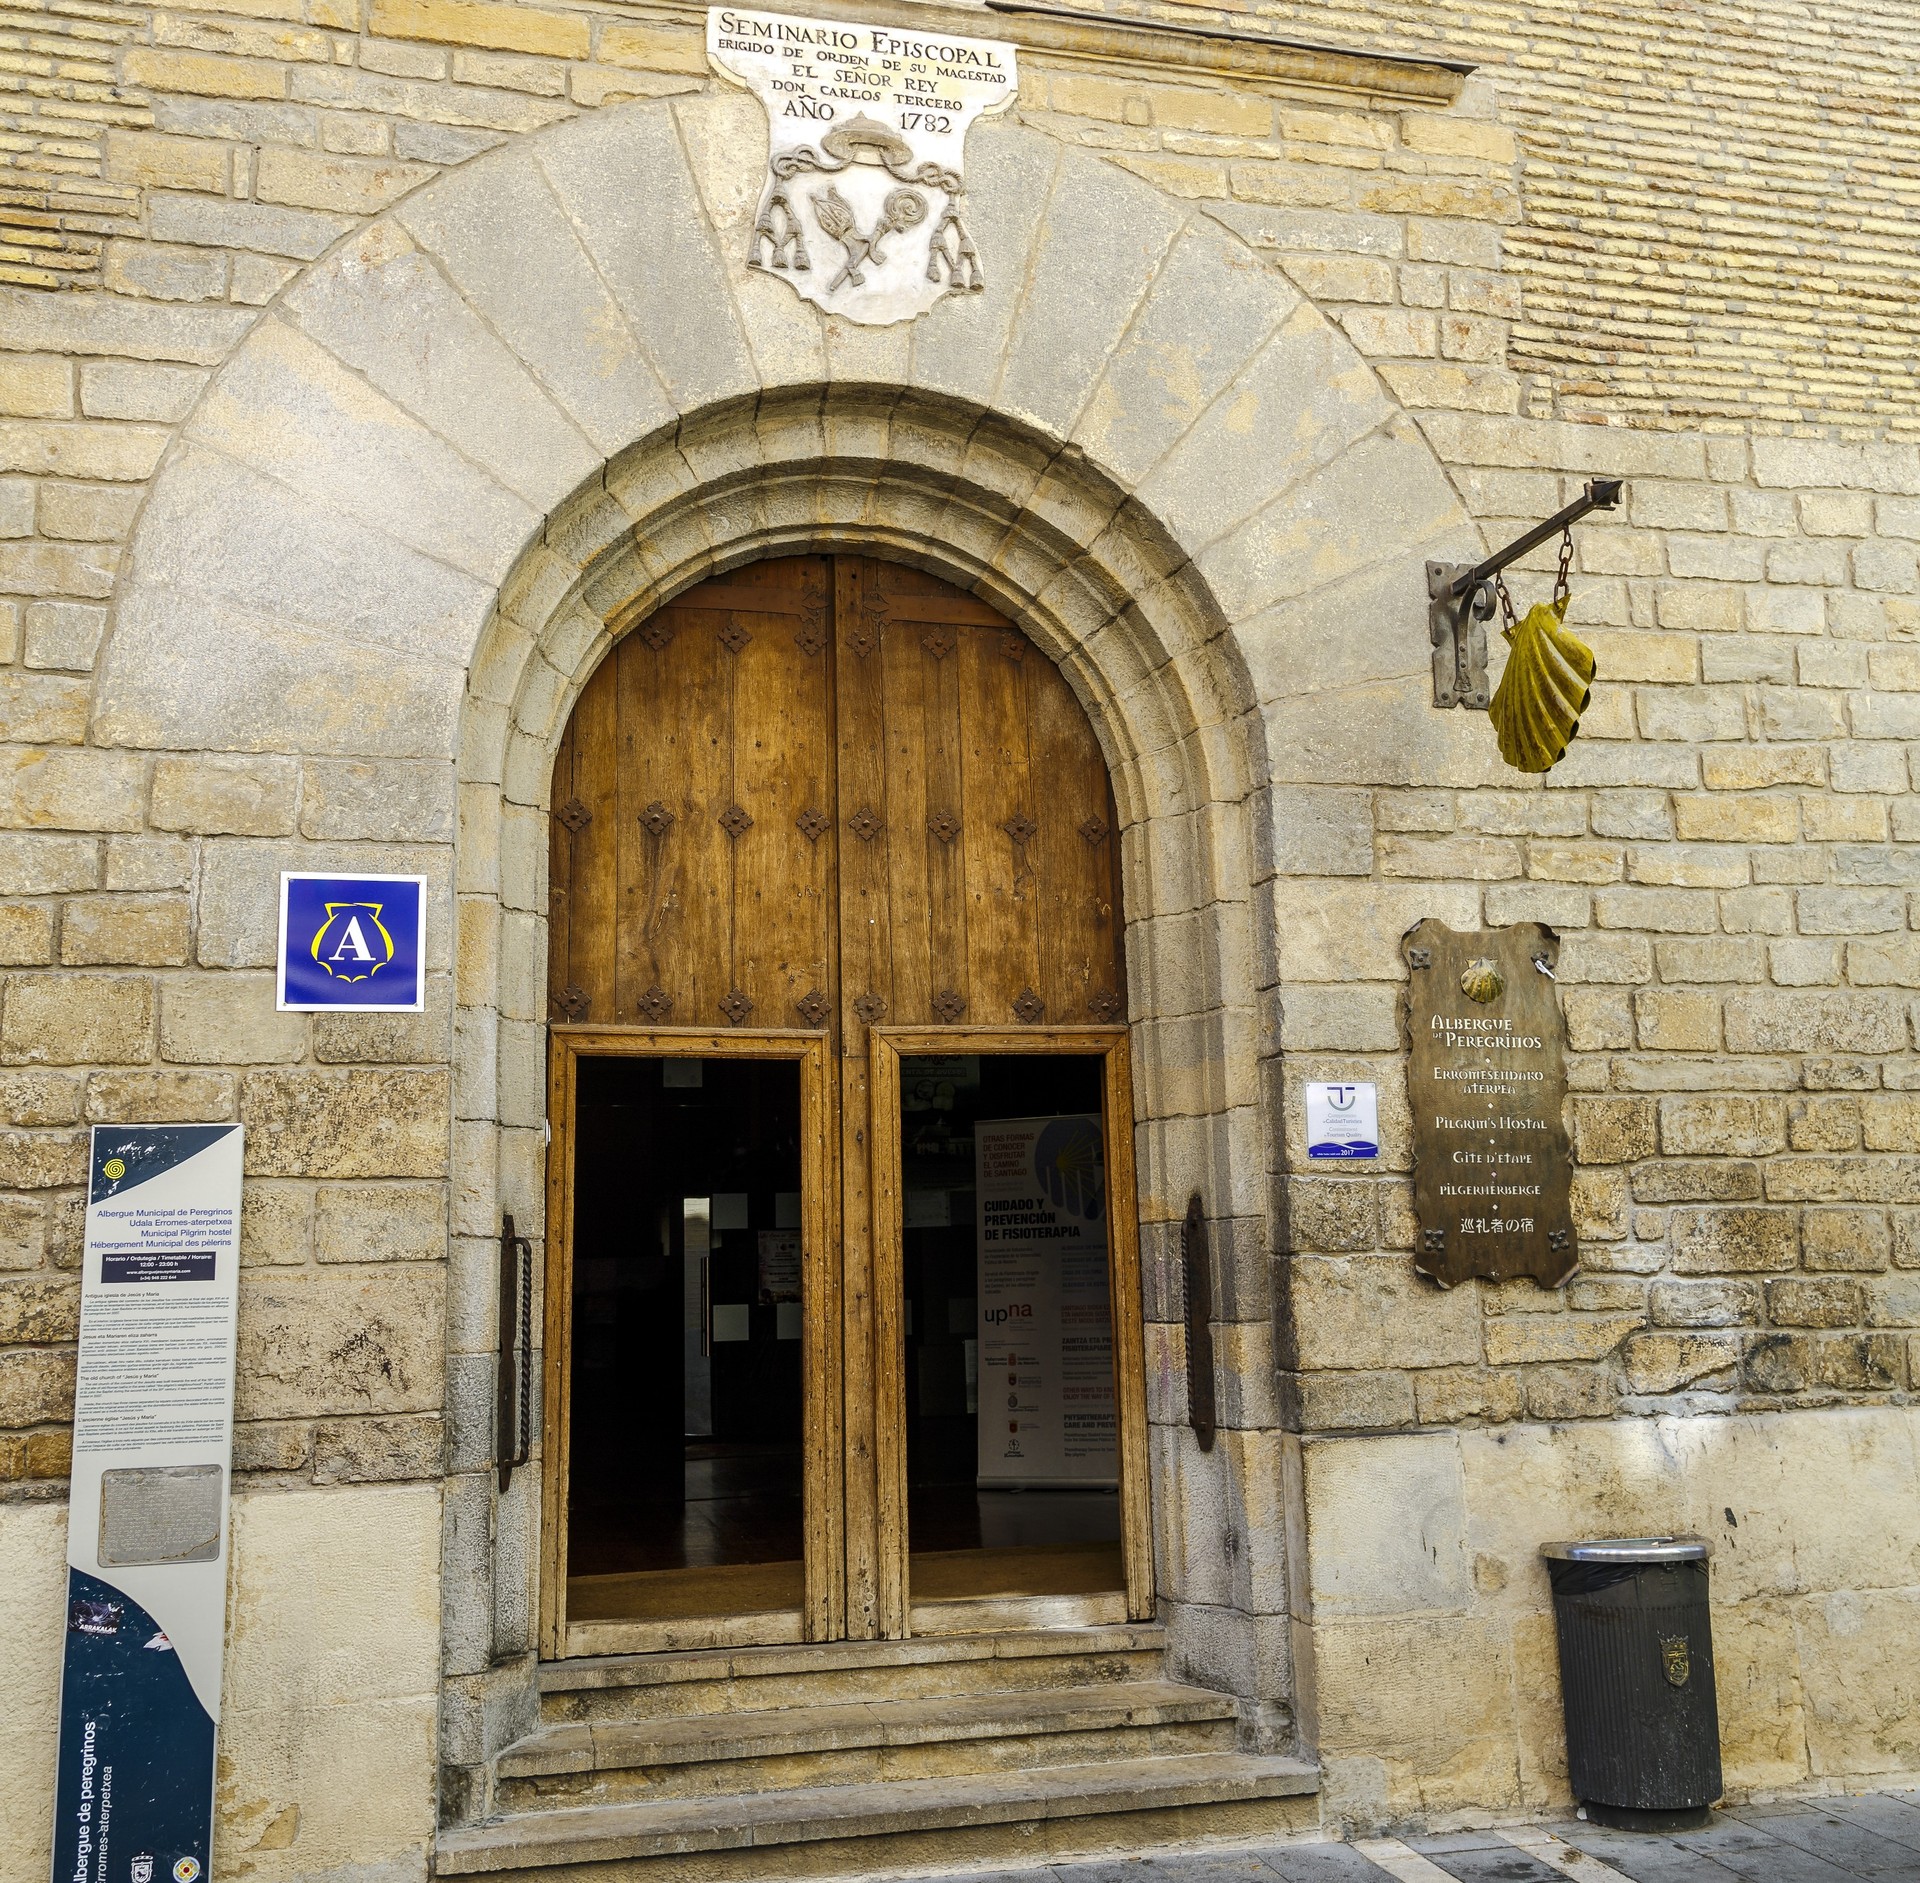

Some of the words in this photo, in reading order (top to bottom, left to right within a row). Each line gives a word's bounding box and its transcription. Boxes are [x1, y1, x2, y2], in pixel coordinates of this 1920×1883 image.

[719, 11, 858, 50] SEMINARIO
[870, 30, 1002, 69] EPISCOPAL
[718, 38, 775, 55] ERIGIDO
[782, 46, 803, 58] DE
[816, 51, 869, 67] ORDEN
[882, 59, 902, 72] DE
[910, 63, 926, 74] SU
[936, 66, 1007, 85] MAGESTAD
[791, 64, 819, 79] EL
[833, 66, 893, 88] SEÑOR
[904, 78, 939, 94] REY
[771, 79, 806, 93] DON
[820, 85, 881, 102] CARLOS
[893, 93, 963, 111] TERCERO
[783, 94, 835, 121] AÑO
[900, 112, 952, 134] 1782
[329, 916, 376, 960] A
[1431, 1014, 1513, 1032] ALBERGUE
[983, 1134, 1005, 1143] OTRAS
[1006, 1133, 1034, 1142] FORMAS
[983, 1144, 992, 1152] DE
[993, 1143, 1025, 1151] CONOCER
[990, 1151, 1025, 1160] DISFRUTAR
[984, 1161, 992, 1169] EL
[993, 1160, 1019, 1168] CAMINO
[984, 1170, 993, 1178] DE
[994, 1168, 1027, 1177] SANTIAGO
[97, 1210, 134, 1218] Albergue
[136, 1209, 175, 1218] Municipal
[190, 1208, 233, 1217] Peregrinos
[984, 1199, 1034, 1212] CUIDADO
[1037, 1198, 1045, 1209] Y
[129, 1219, 152, 1227] Udala
[155, 1218, 233, 1227] Erromes-aterpetxea
[984, 1210, 1055, 1226] PREVENCIÓN
[1460, 1217, 1534, 1234] 巡礼者の宿
[140, 1229, 178, 1238] Municipal
[180, 1229, 207, 1237] Pilgrim
[208, 1228, 232, 1236] hostel
[985, 1230, 999, 1240] DE
[1002, 1226, 1080, 1239] FISIOTERAPIA
[146, 1240, 183, 1249] Municipal
[185, 1239, 199, 1247] des
[81, 1721, 98, 1799] peregrinos
[76, 1801, 92, 1822] de
[95, 1766, 113, 1883] rromes-aterpetxea
[73, 1825, 91, 1883] lbergue
